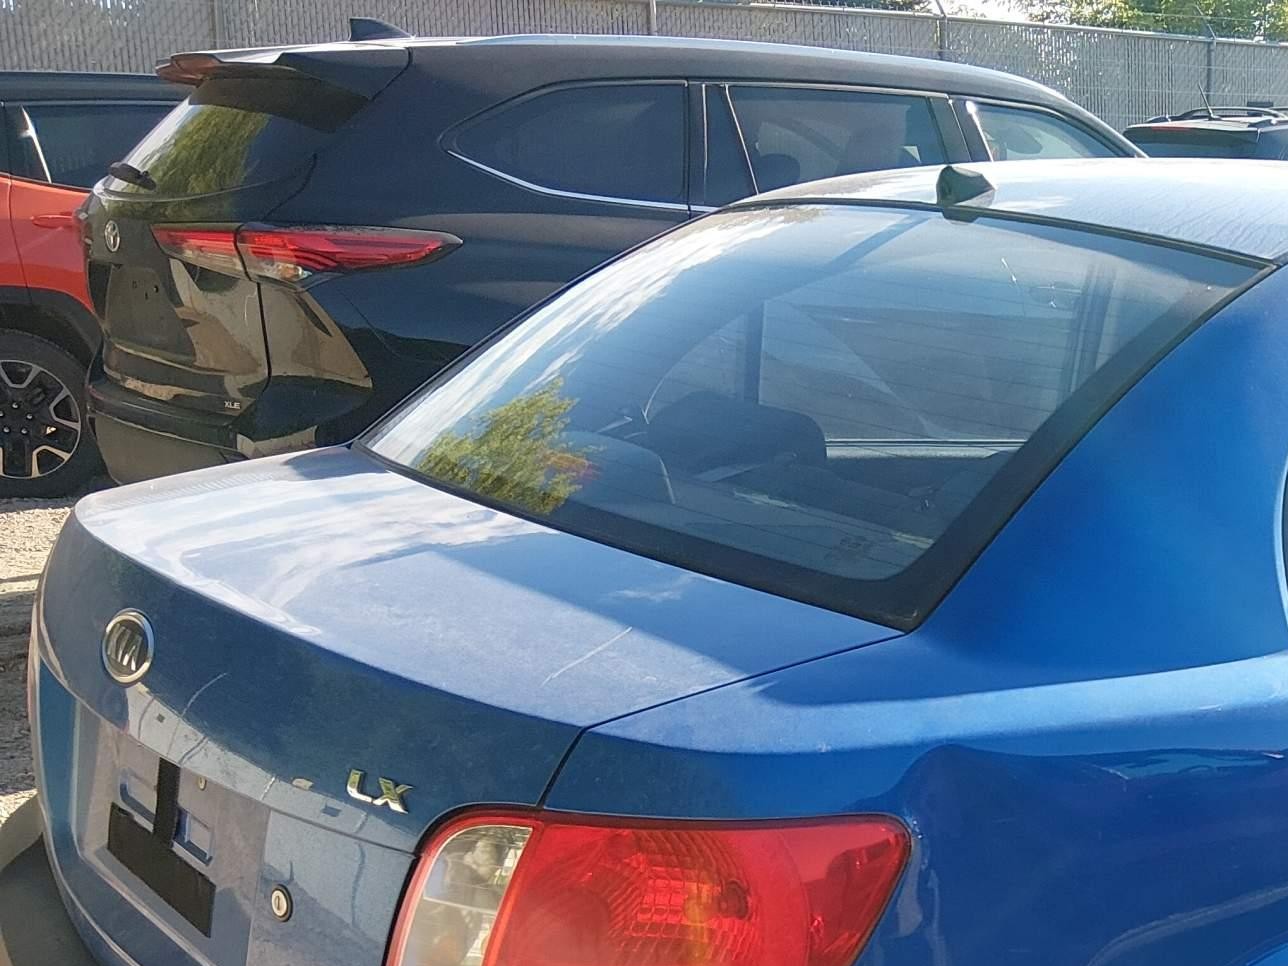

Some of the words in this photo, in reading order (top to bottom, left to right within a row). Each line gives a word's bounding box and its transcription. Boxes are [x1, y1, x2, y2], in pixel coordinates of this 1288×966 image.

[224, 401, 241, 410] XLE
[107, 623, 143, 671] KIA
[347, 769, 414, 815] LX
